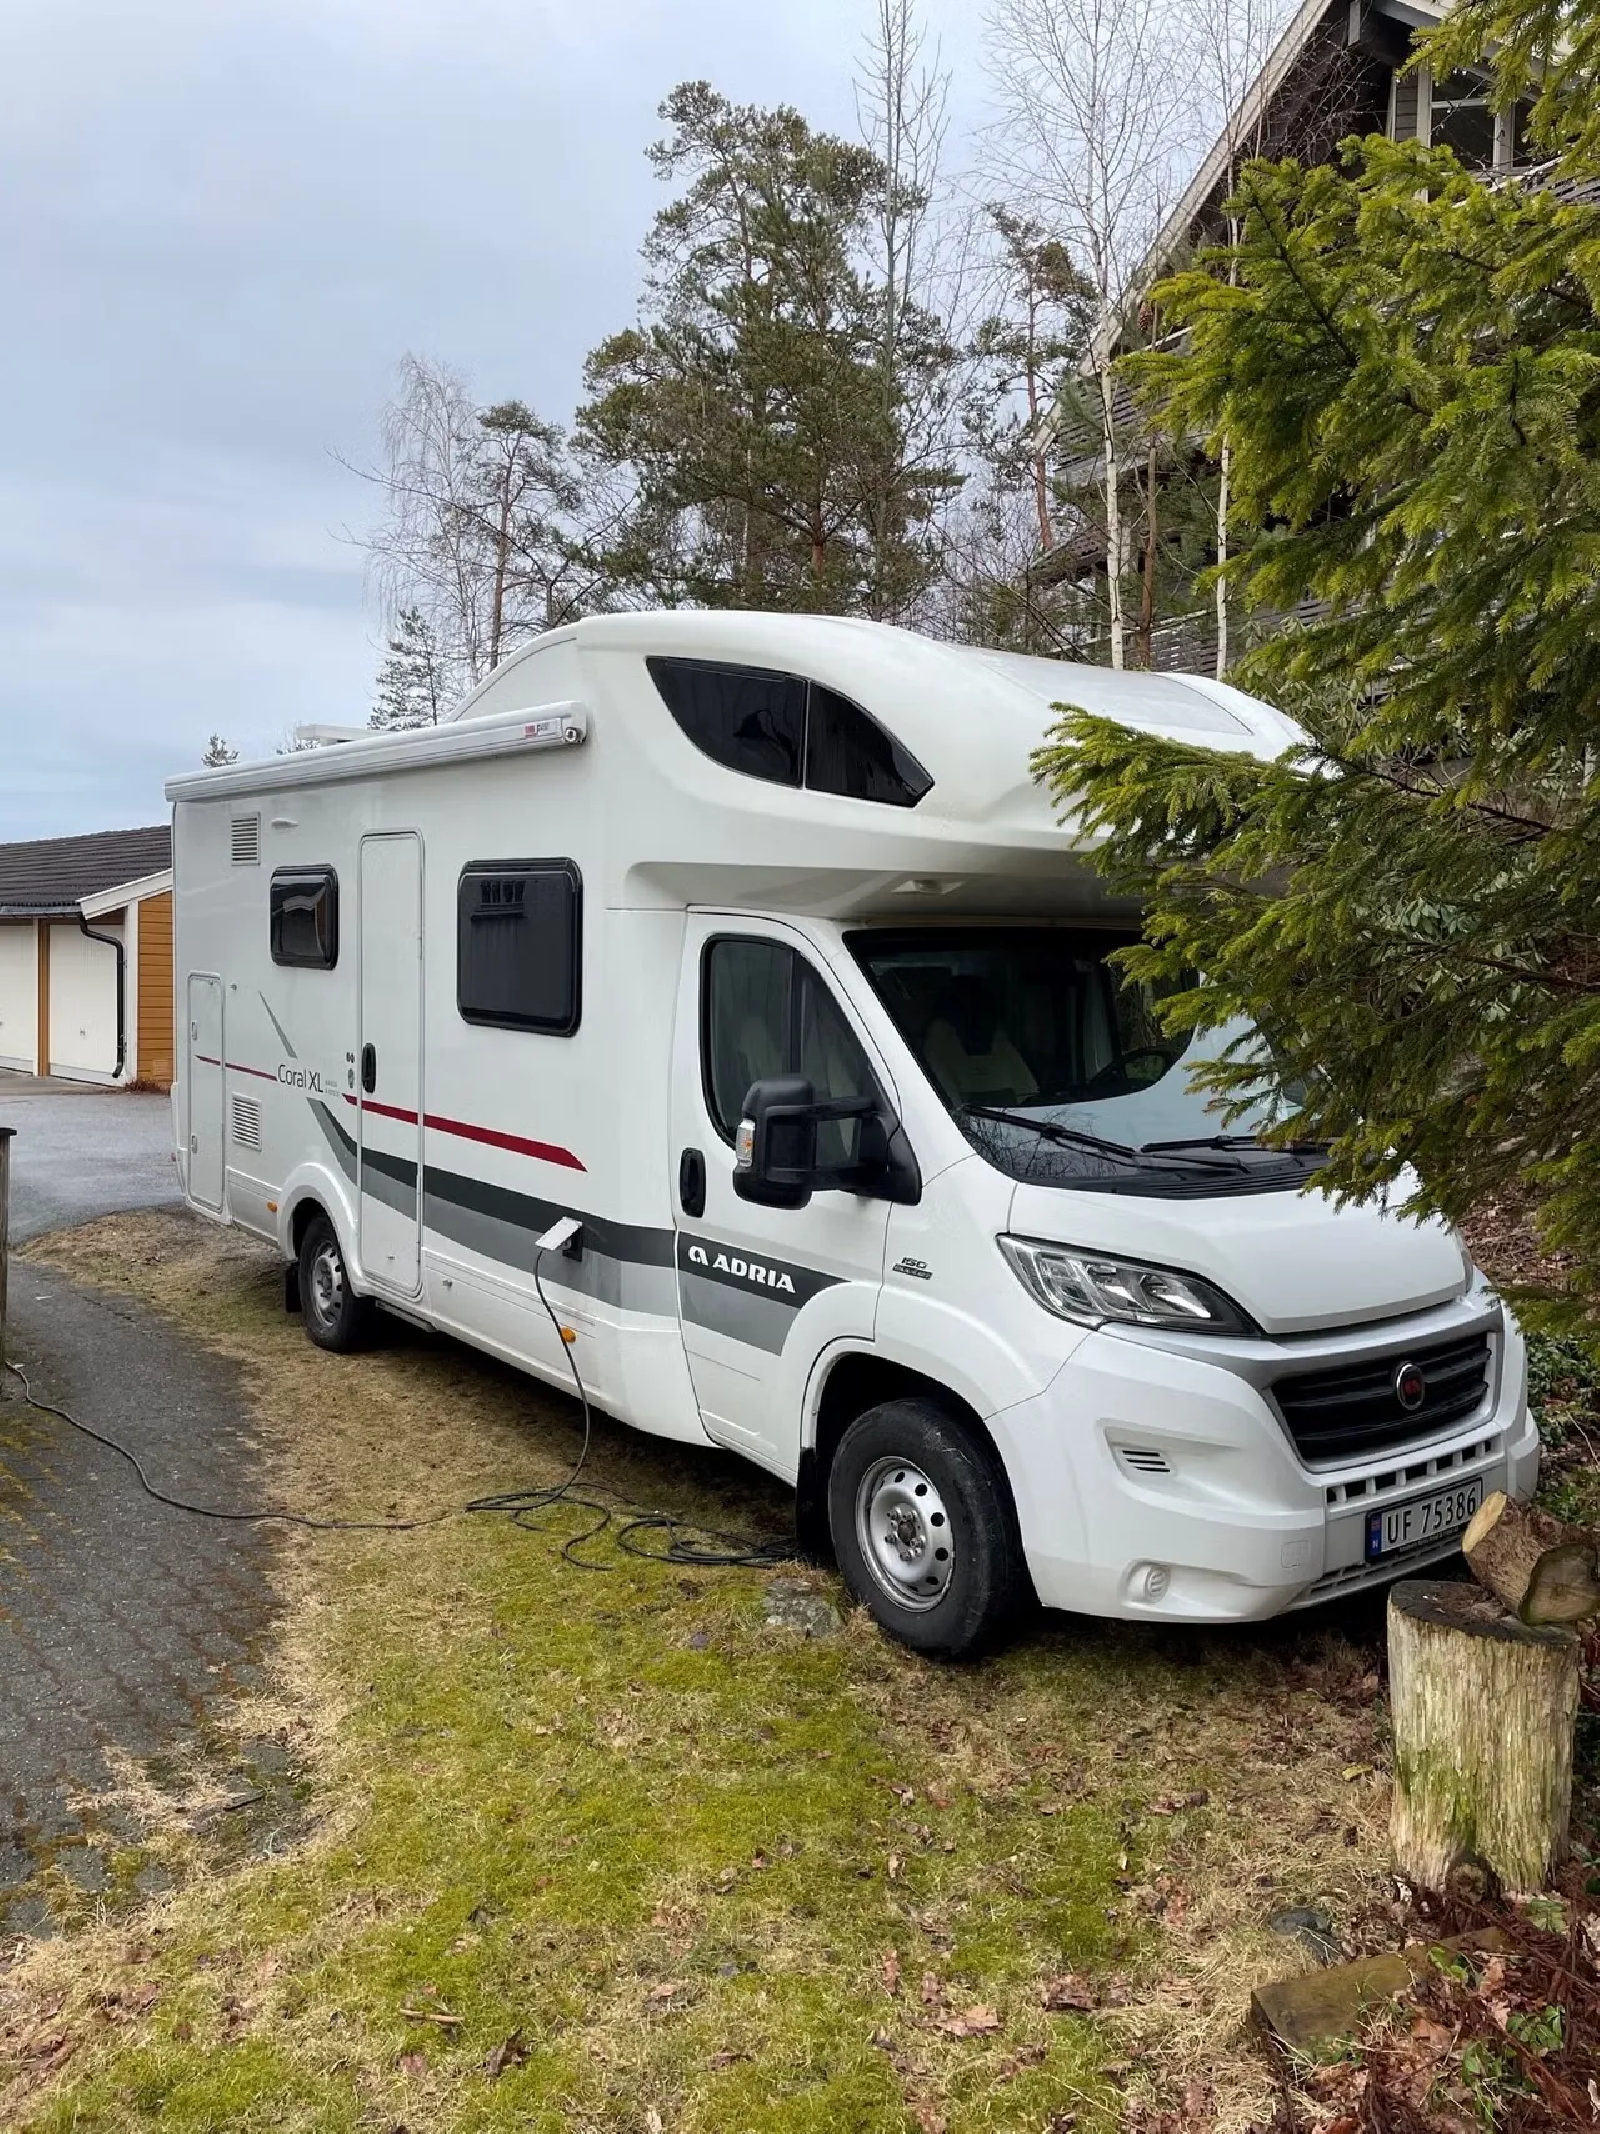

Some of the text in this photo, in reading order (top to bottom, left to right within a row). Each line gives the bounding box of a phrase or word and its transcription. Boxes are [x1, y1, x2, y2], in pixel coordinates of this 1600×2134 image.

[278, 1064, 323, 1092] Coral XL
[712, 1252, 796, 1294] ADRIA
[1387, 1510, 1412, 1544] UF
[1421, 1487, 1476, 1534] 75386
